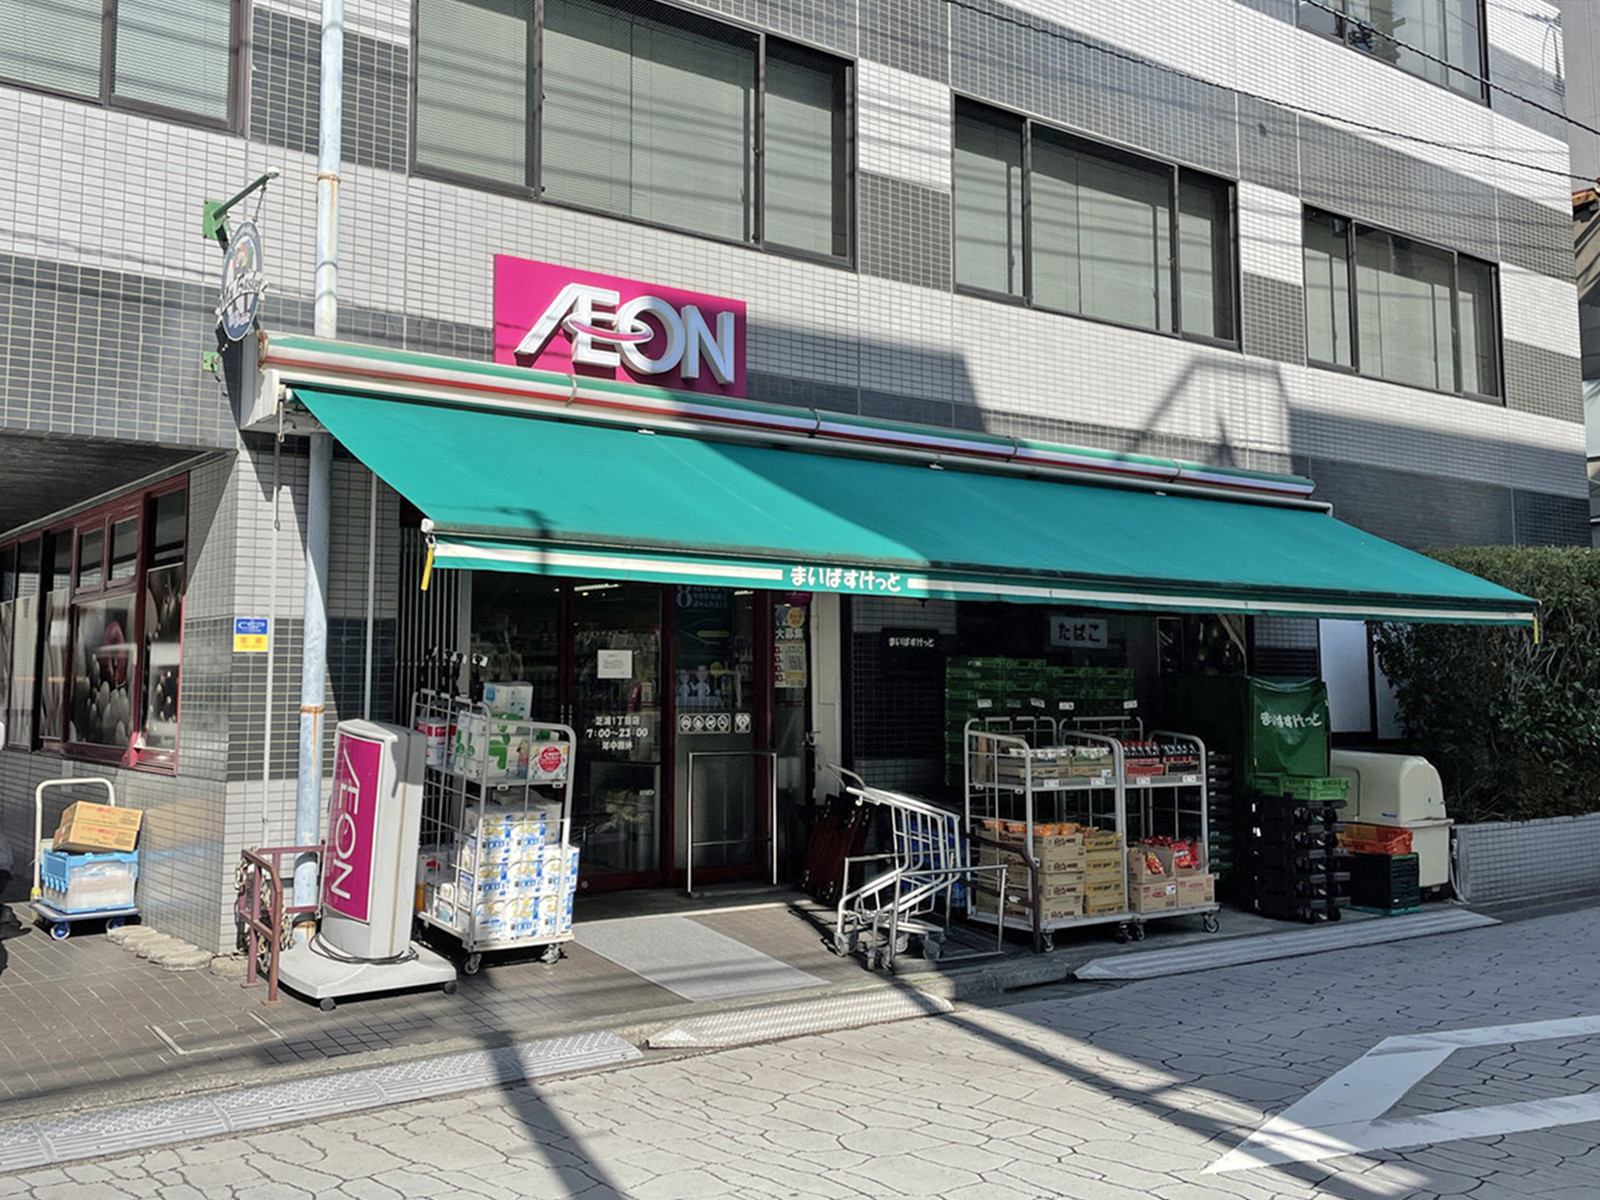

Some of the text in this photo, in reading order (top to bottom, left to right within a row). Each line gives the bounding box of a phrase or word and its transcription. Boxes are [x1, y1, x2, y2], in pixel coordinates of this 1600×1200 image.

[514, 282, 735, 385] AEON
[790, 565, 901, 592] まいばすけっと
[1058, 622, 1101, 642] たばこ
[1260, 711, 1322, 728] まばすけっと
[330, 747, 361, 900] AEON
